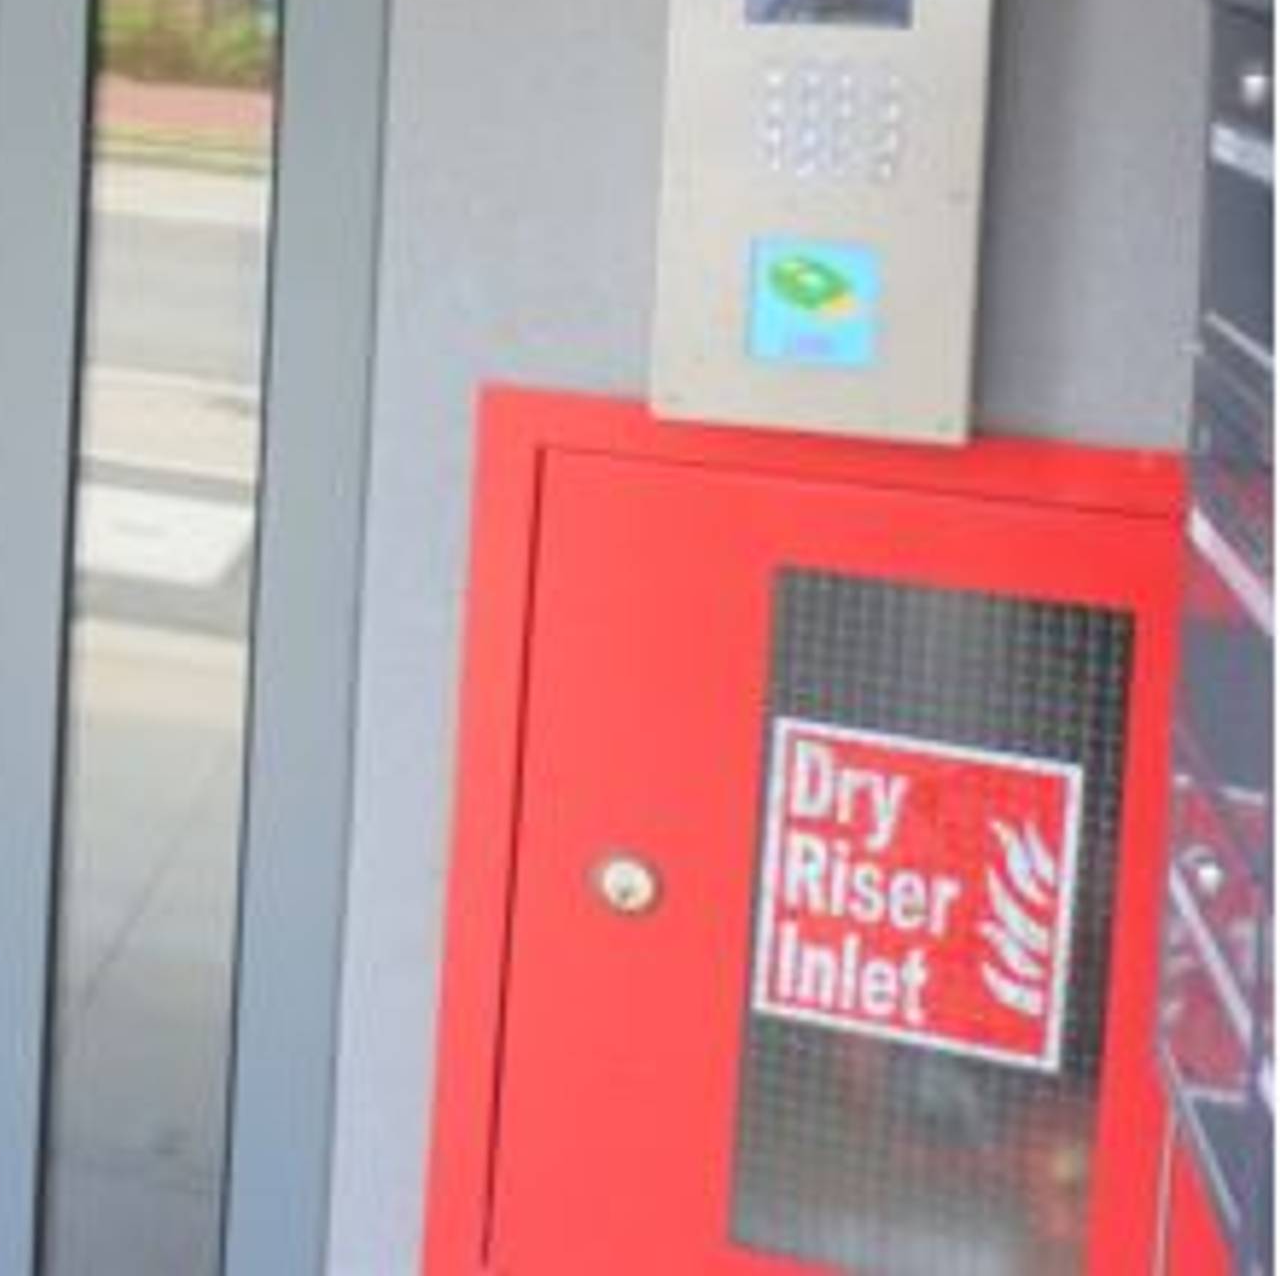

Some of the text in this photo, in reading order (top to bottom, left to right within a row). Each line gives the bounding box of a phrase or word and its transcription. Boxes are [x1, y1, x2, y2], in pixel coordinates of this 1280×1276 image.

[790, 738, 910, 851] Dry
[785, 828, 962, 937] Riser
[776, 920, 929, 1026] Inlet
